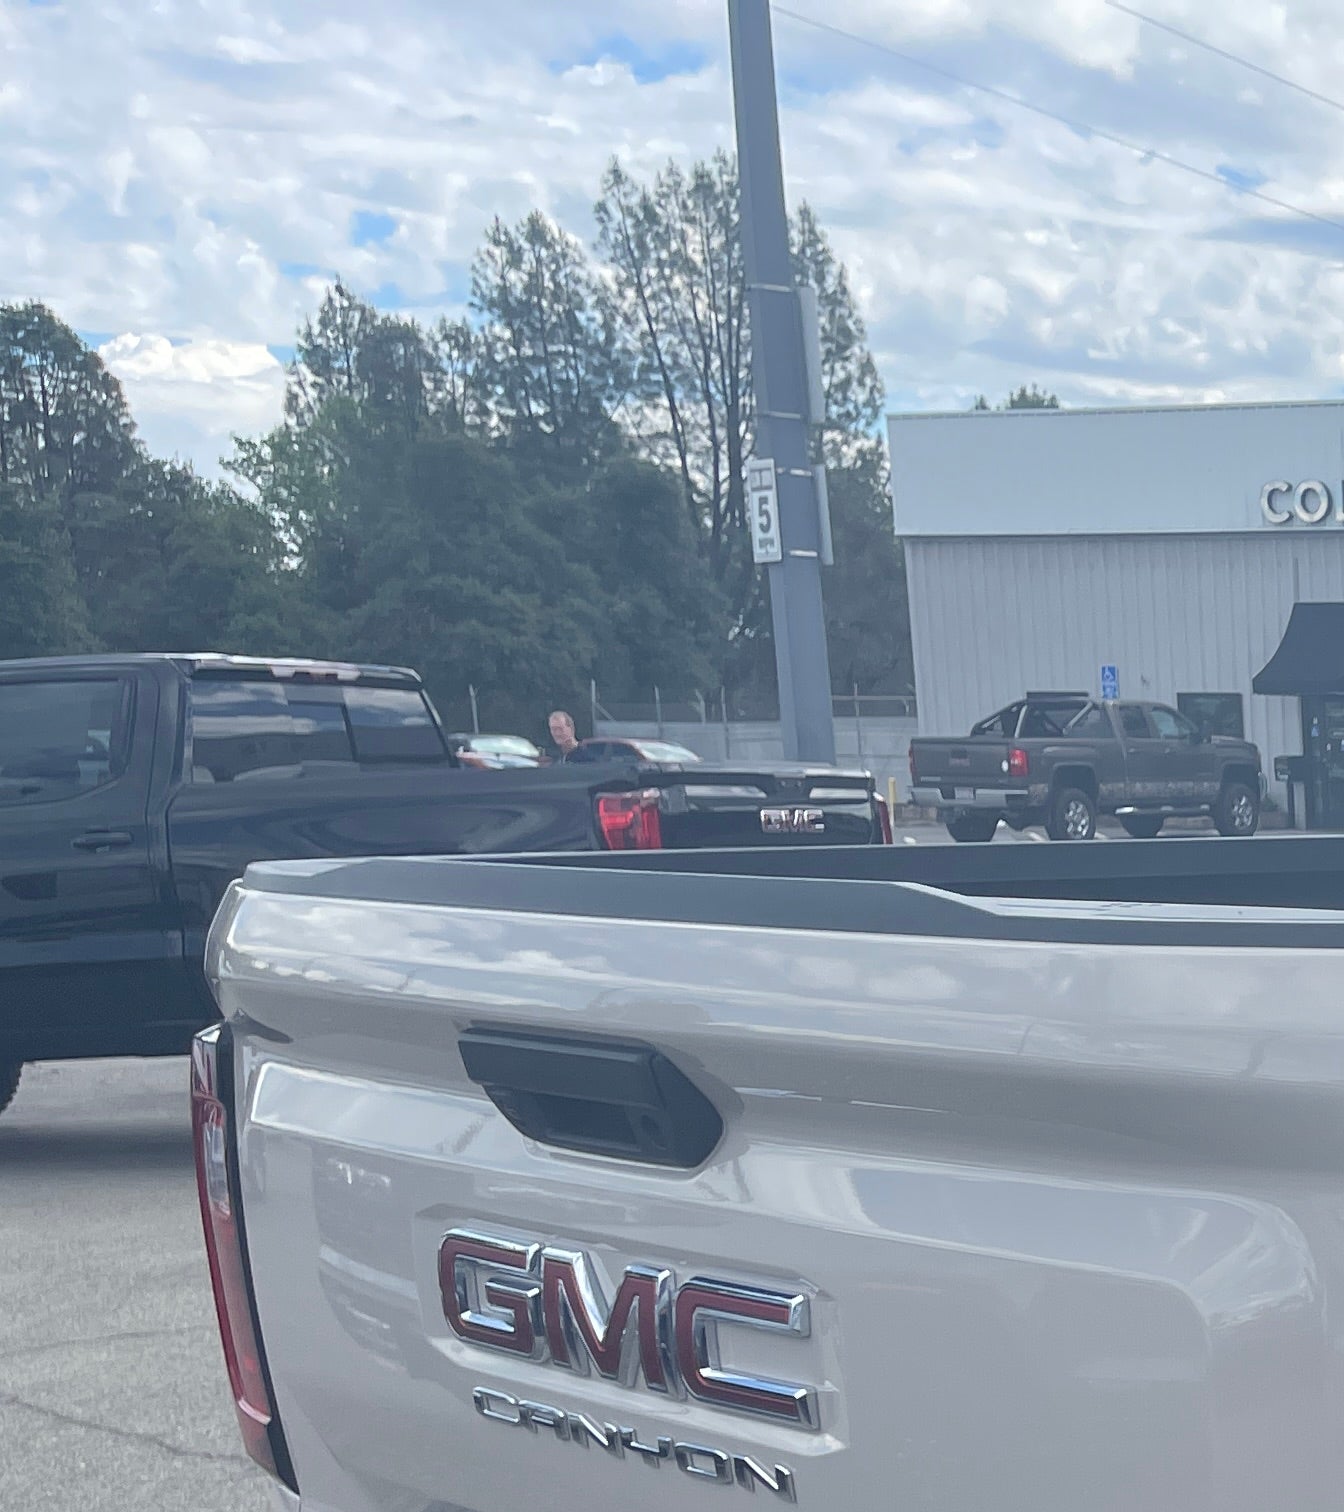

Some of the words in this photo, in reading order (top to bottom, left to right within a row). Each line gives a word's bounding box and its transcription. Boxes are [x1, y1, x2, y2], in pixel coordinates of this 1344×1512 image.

[760, 808, 825, 833] GMC
[438, 1228, 820, 1430] GMC
[473, 1386, 798, 1502] CANYON
